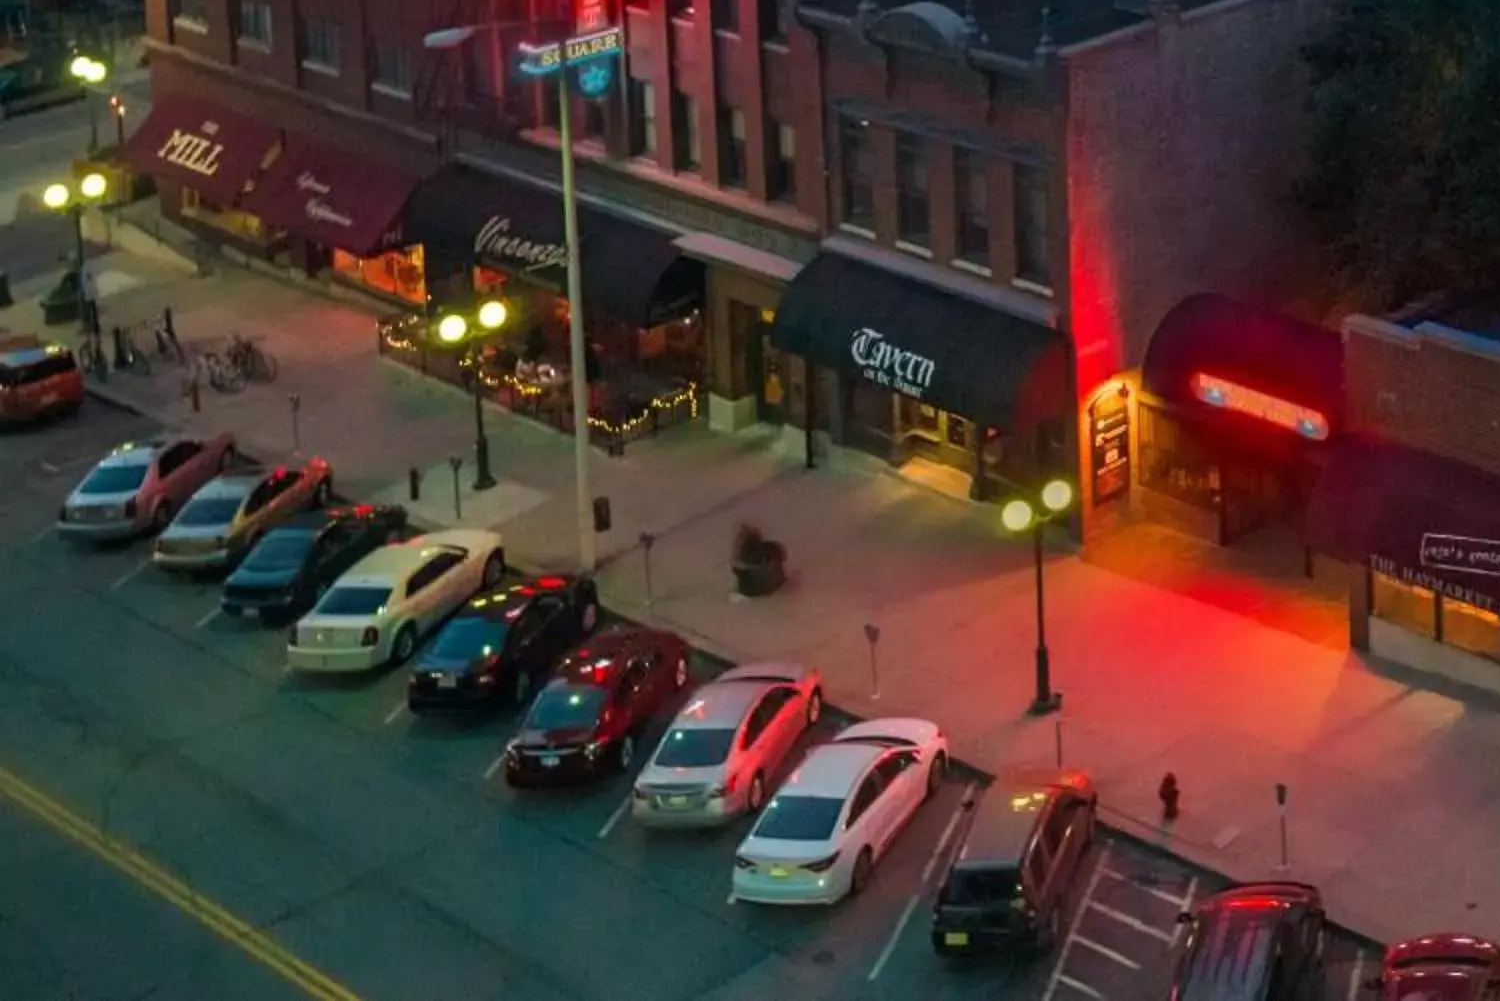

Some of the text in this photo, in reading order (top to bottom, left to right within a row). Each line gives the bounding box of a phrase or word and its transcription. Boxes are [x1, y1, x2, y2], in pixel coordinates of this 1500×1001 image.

[157, 128, 224, 176] MILL
[851, 327, 935, 387] Tavern
[1369, 554, 1397, 574] THE
[1403, 565, 1494, 609] HAYMARKET
